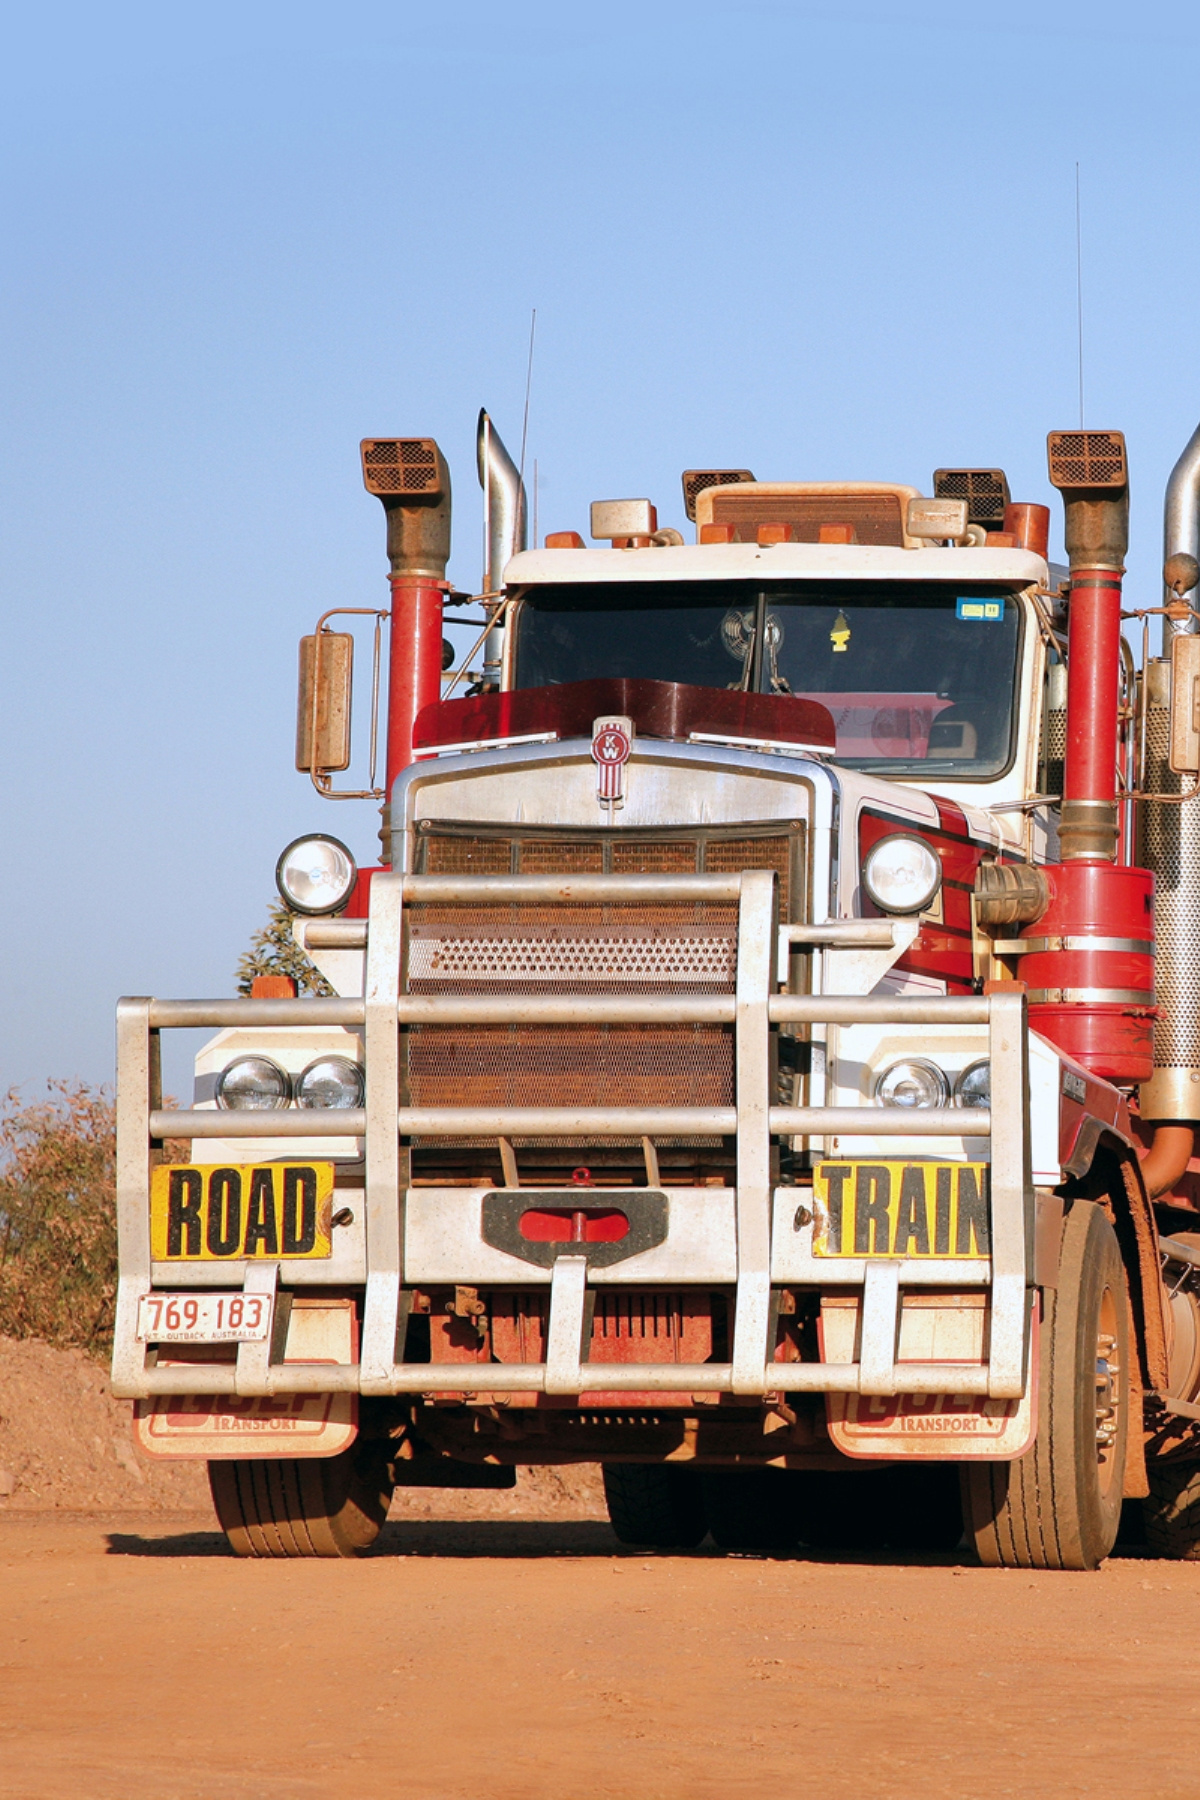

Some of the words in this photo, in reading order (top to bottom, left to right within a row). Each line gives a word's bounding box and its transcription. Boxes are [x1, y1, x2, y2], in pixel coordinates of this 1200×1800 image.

[166, 1166, 317, 1257] ROAD
[820, 1164, 992, 1255] TRAIN
[213, 1415, 298, 1431] TRANSPORT
[900, 1415, 980, 1432] TRANSPORT
